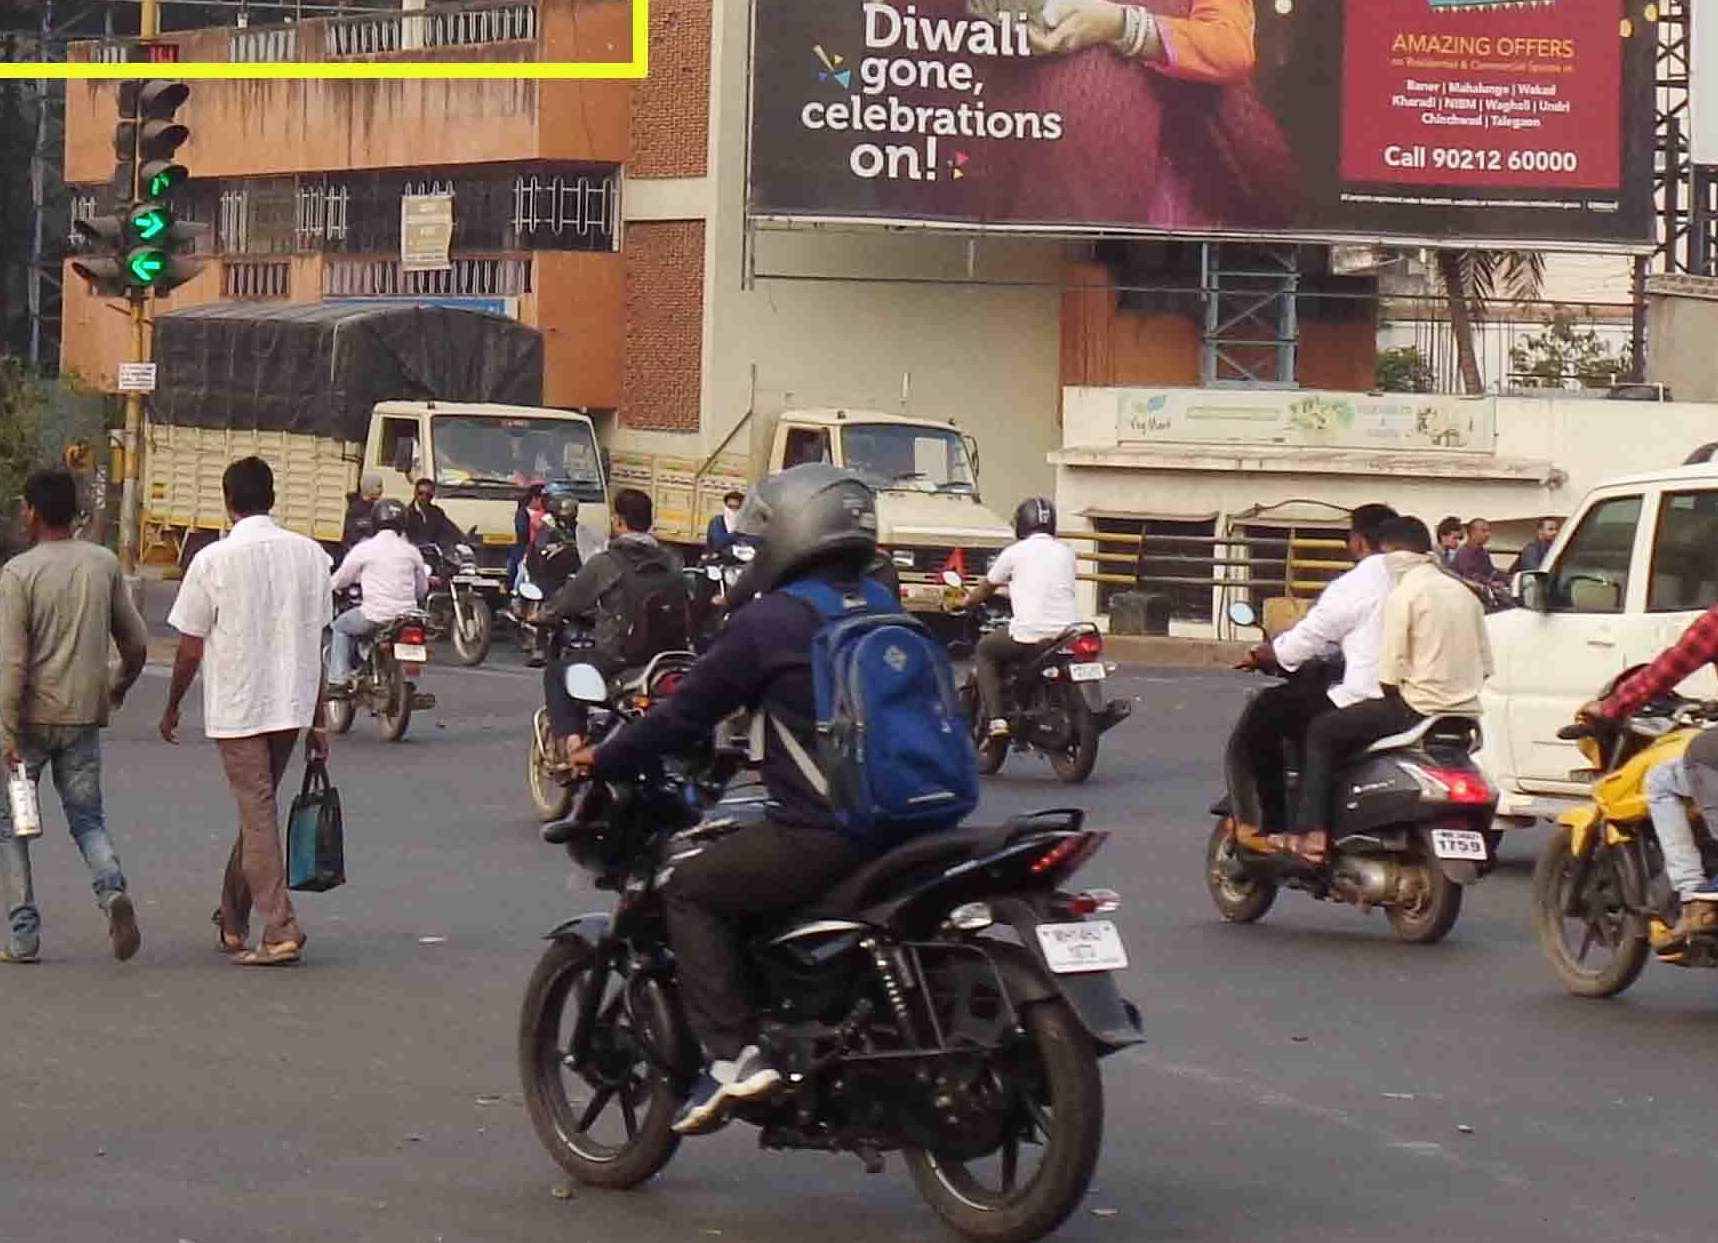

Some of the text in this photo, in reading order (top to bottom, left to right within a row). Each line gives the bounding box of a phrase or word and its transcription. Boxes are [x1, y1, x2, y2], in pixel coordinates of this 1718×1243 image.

[863, 3, 1031, 57] Diwali
[1392, 34, 1575, 58] AMAZING OFFERS
[860, 55, 984, 95] gone,
[1406, 79, 1440, 92] Baner
[1518, 83, 1556, 96] Wakad
[801, 95, 1063, 139] celebrations
[1391, 95, 1436, 109] Kharadi
[1538, 100, 1571, 113] Undri
[1421, 113, 1541, 129] Chinchwad Talegaon
[849, 136, 938, 181] on!
[1384, 145, 1578, 172] Call 90212 60000
